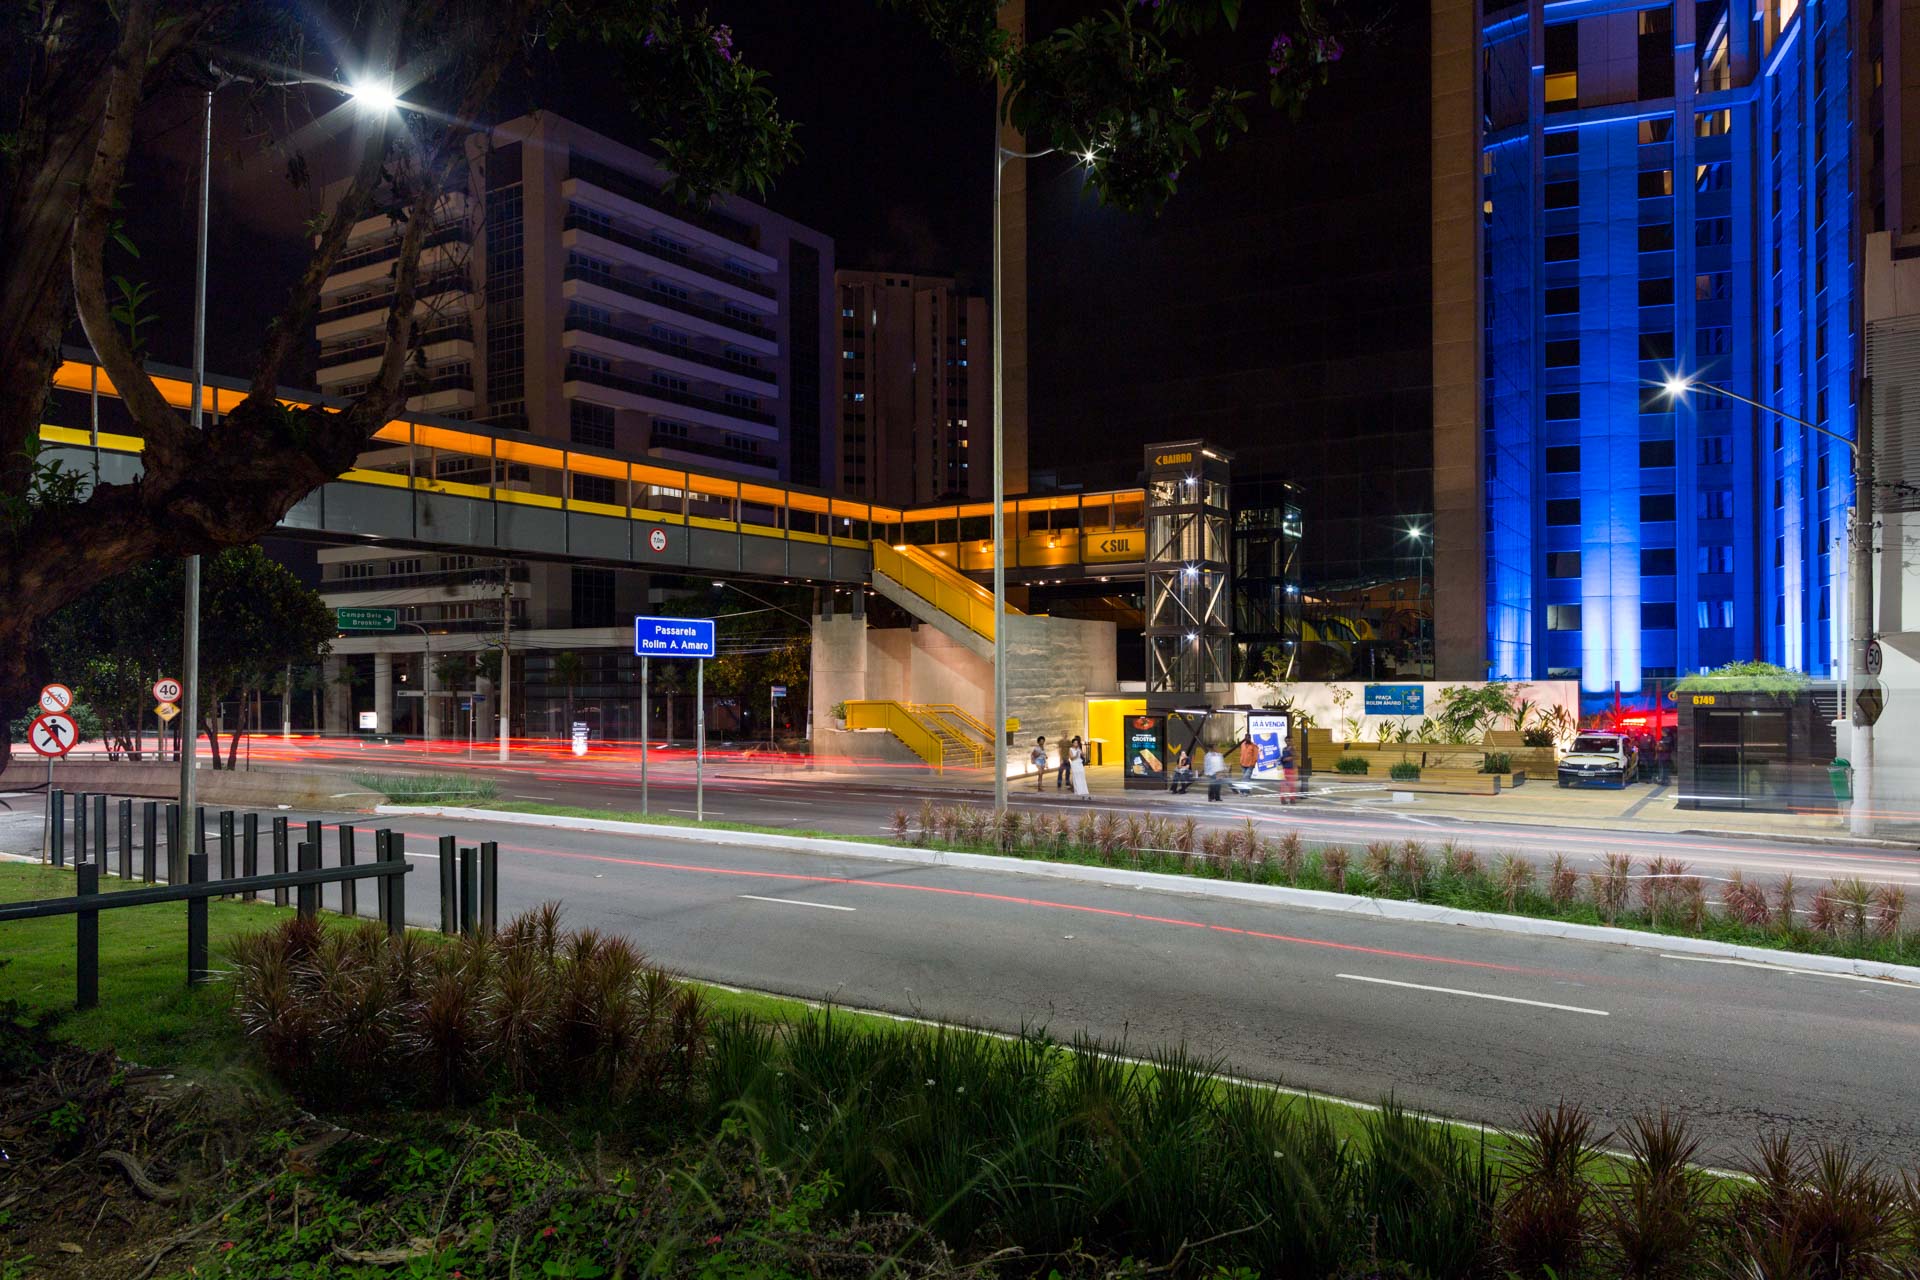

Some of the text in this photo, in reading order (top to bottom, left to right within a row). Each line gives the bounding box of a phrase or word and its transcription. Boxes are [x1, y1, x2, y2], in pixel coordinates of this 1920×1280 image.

[1162, 452, 1192, 465] BAIRRO
[1110, 539, 1130, 552] SUL
[341, 611, 365, 619] Campo
[655, 625, 697, 636] Passarela
[642, 639, 709, 650] Rolim A. Amaro
[1869, 649, 1879, 666] 50
[159, 684, 178, 696] 40
[1692, 695, 1715, 705] 6749
